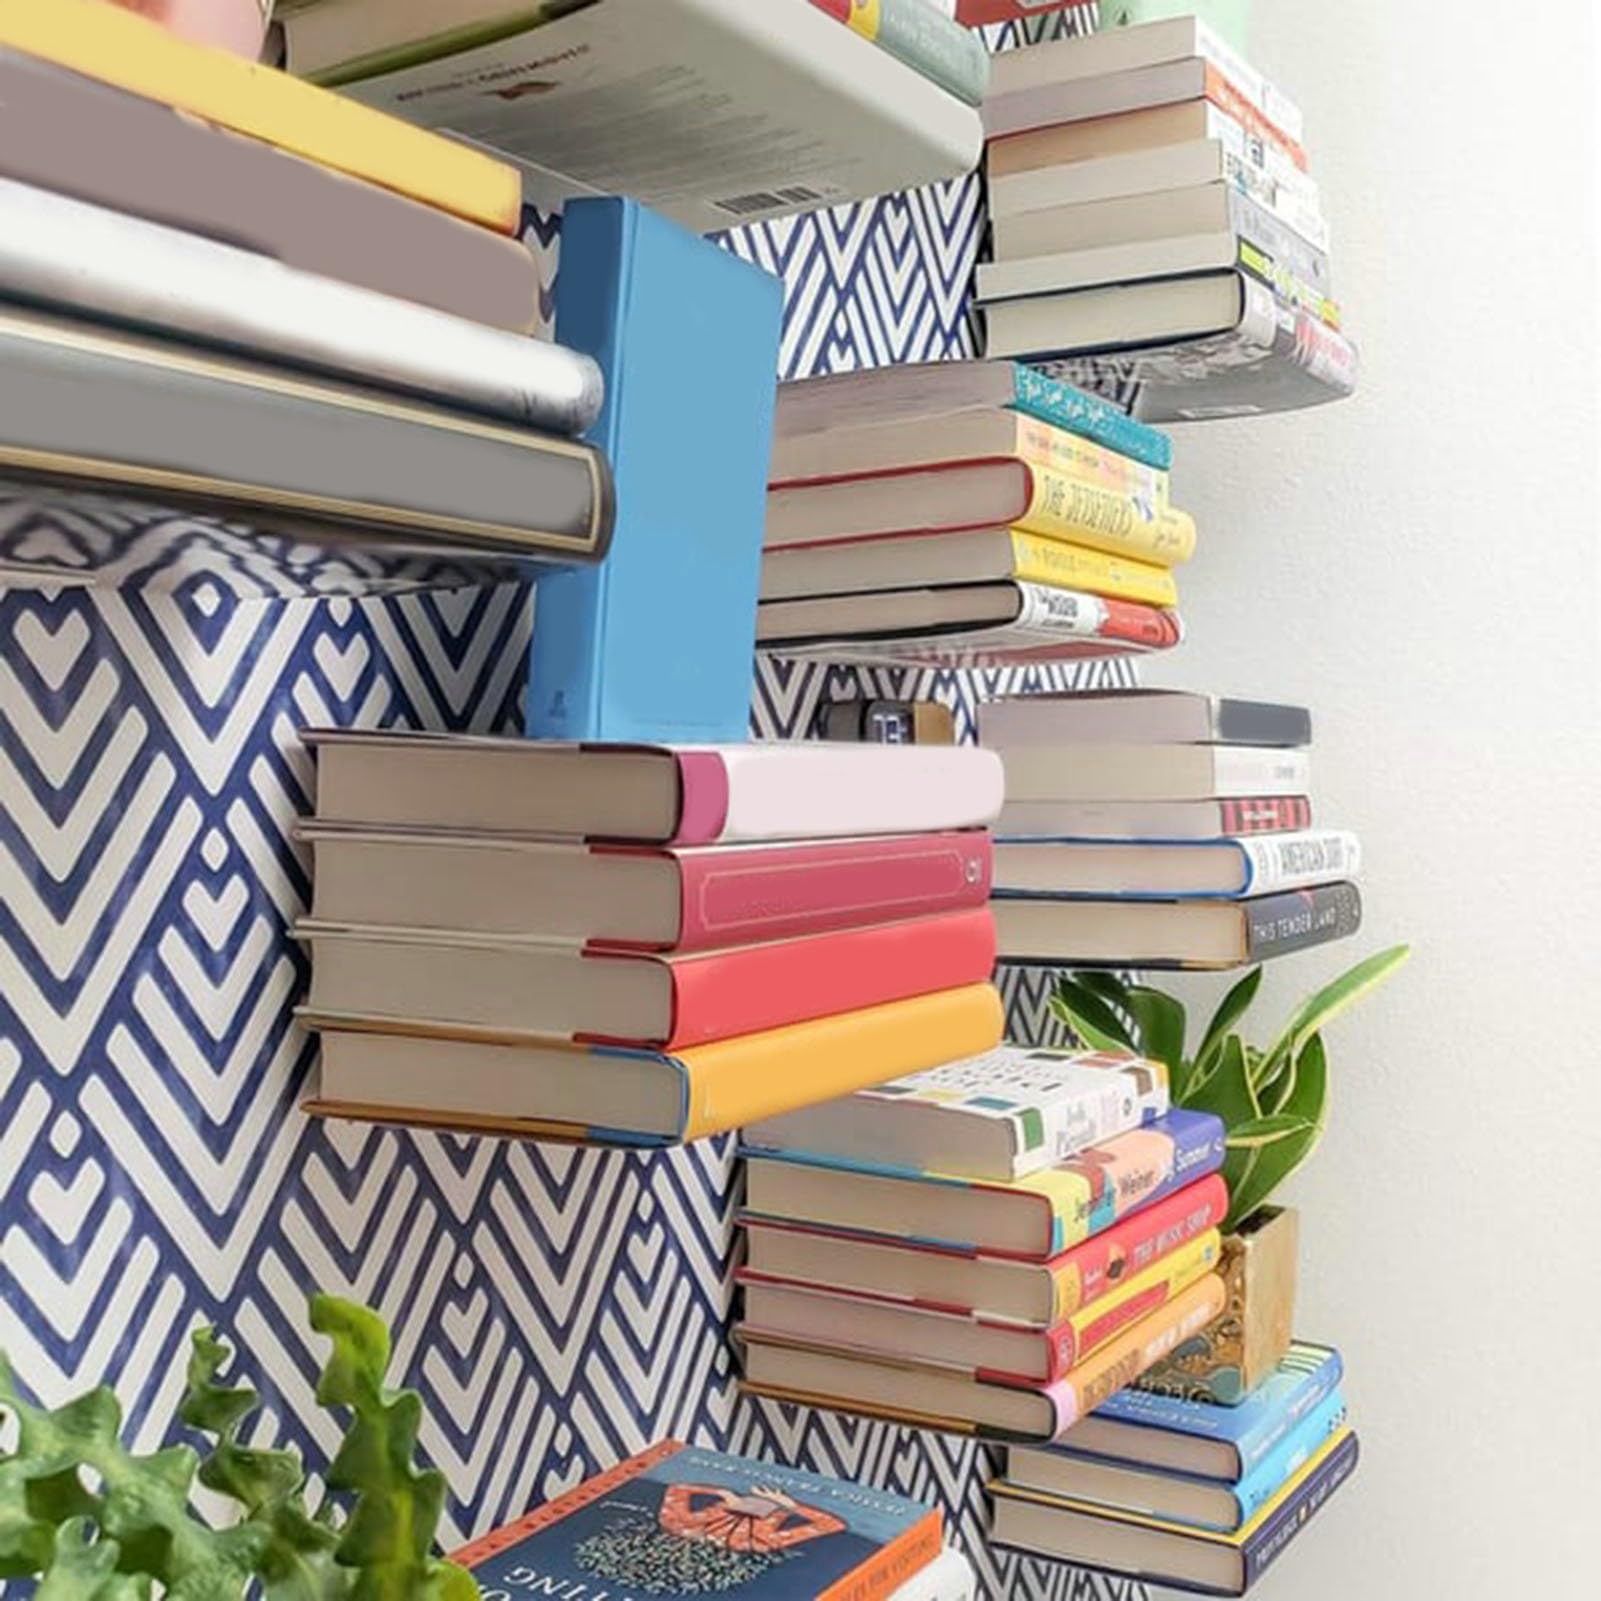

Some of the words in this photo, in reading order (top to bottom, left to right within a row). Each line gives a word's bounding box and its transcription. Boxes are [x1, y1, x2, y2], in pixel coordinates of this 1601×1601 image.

[1278, 840, 1324, 875] AMERICAN
[1253, 922, 1277, 942] THIS
[1277, 912, 1311, 938] TENDER
